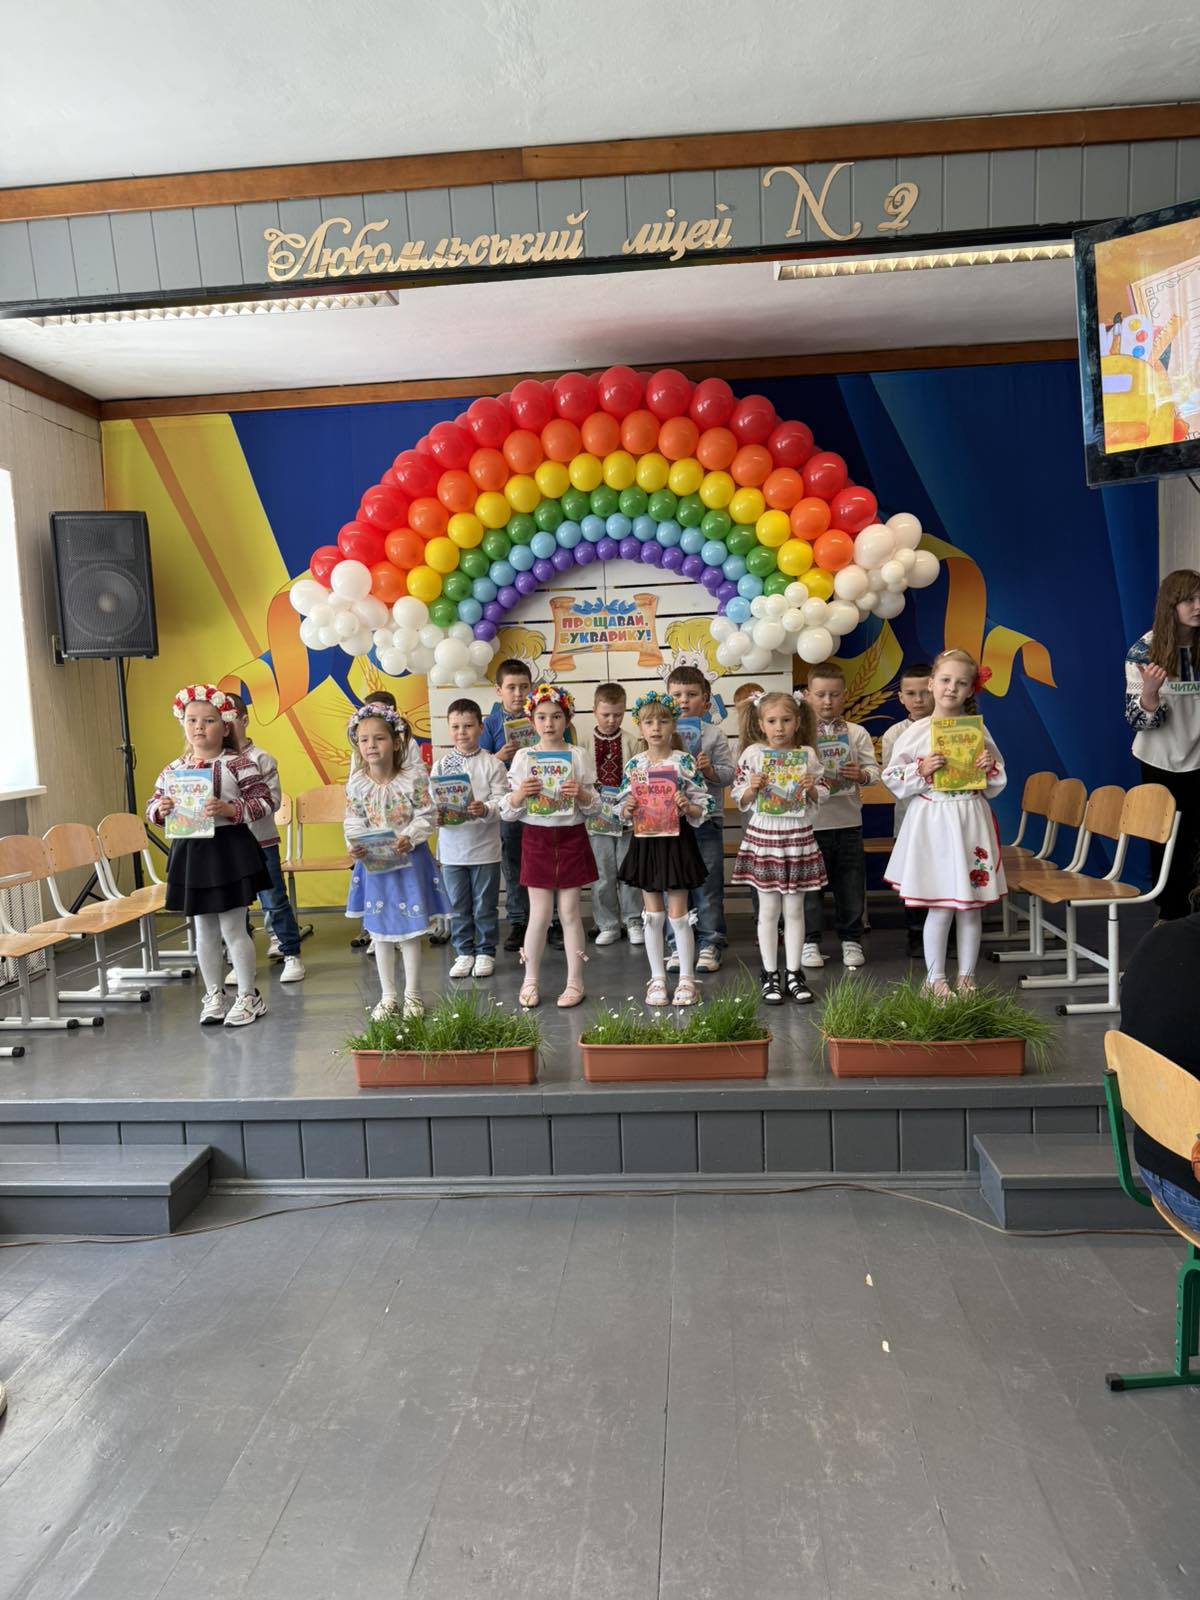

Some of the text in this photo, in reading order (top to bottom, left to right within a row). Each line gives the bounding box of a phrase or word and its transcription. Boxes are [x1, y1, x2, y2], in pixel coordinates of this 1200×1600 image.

[622, 201, 733, 262] ліцей
[875, 182, 920, 232] 2
[560, 629, 651, 644] БУКВАРИКУ!
[530, 765, 568, 776] БУКВАР
